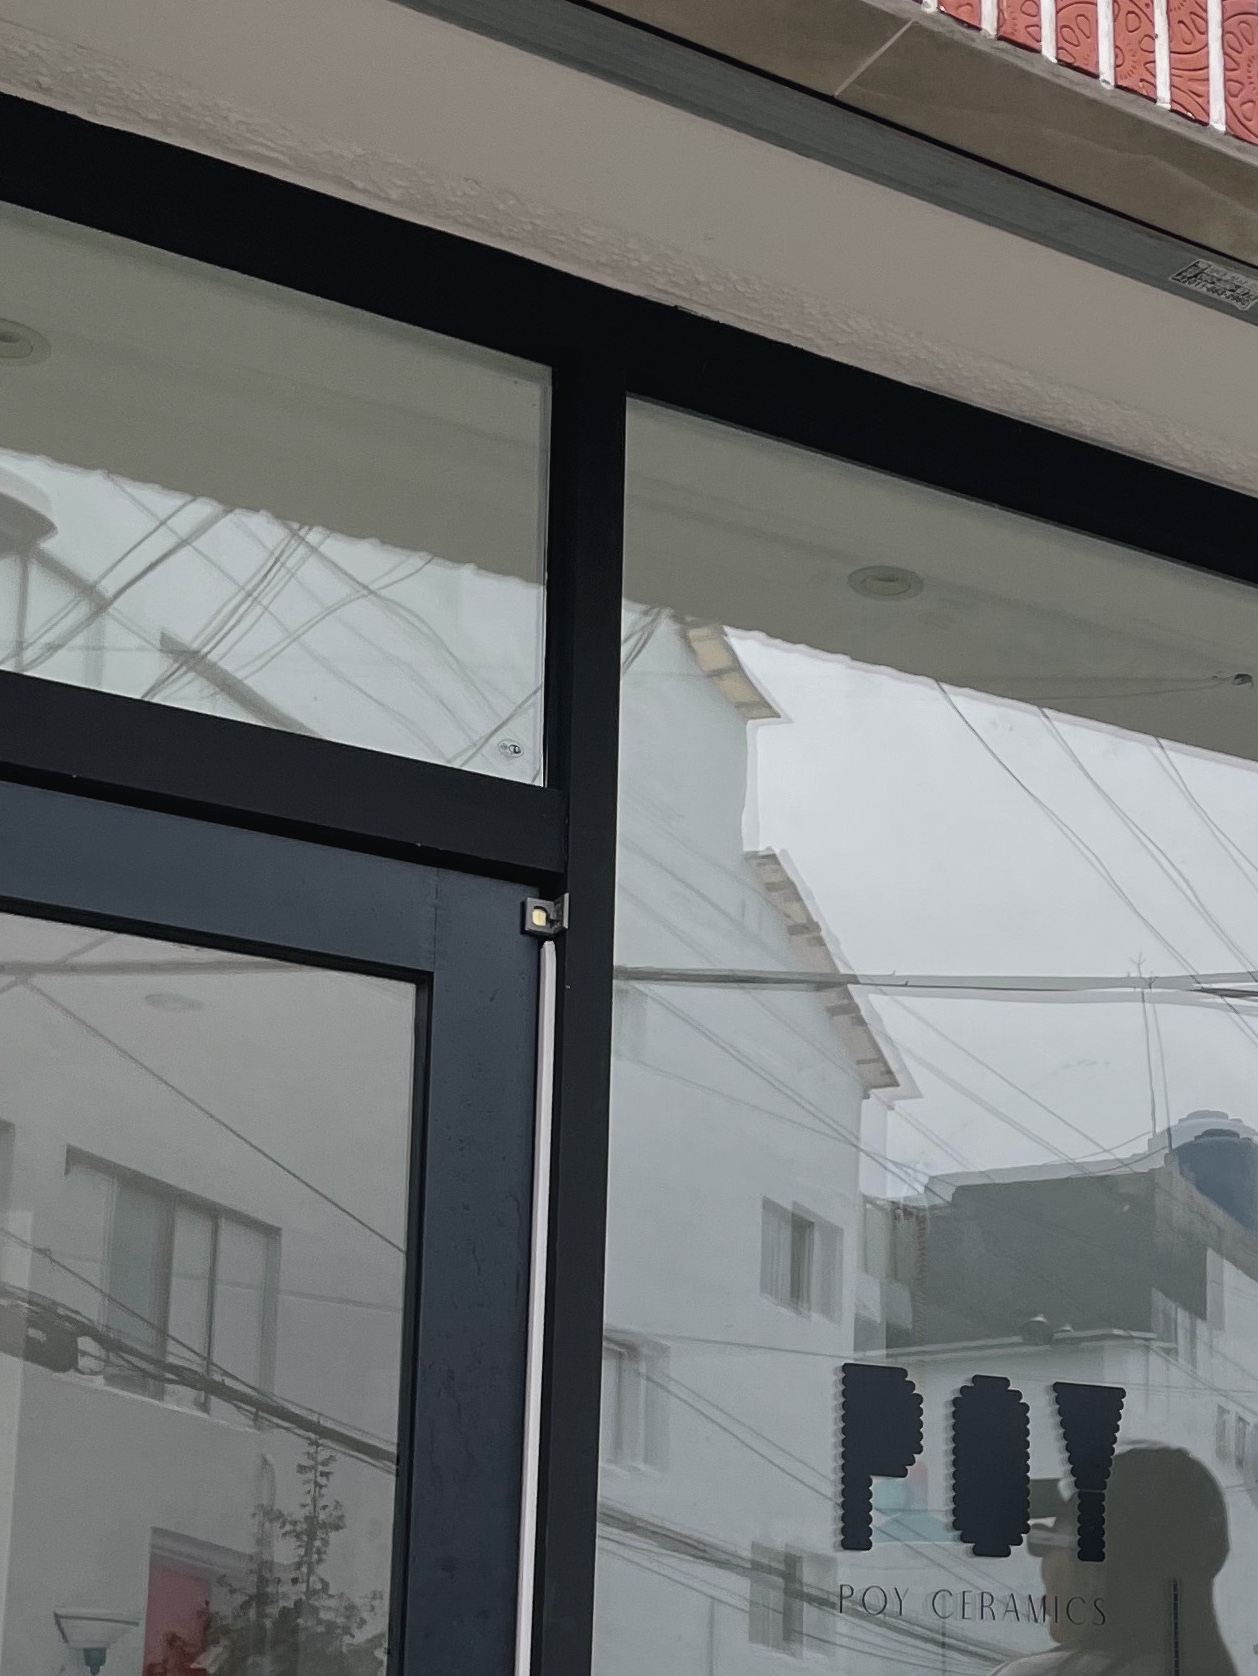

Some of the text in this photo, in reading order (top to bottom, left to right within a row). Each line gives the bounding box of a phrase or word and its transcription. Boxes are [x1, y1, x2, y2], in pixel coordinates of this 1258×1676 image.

[841, 1363, 1126, 1562] POY
[839, 1584, 1107, 1626] POY CERAMICS
